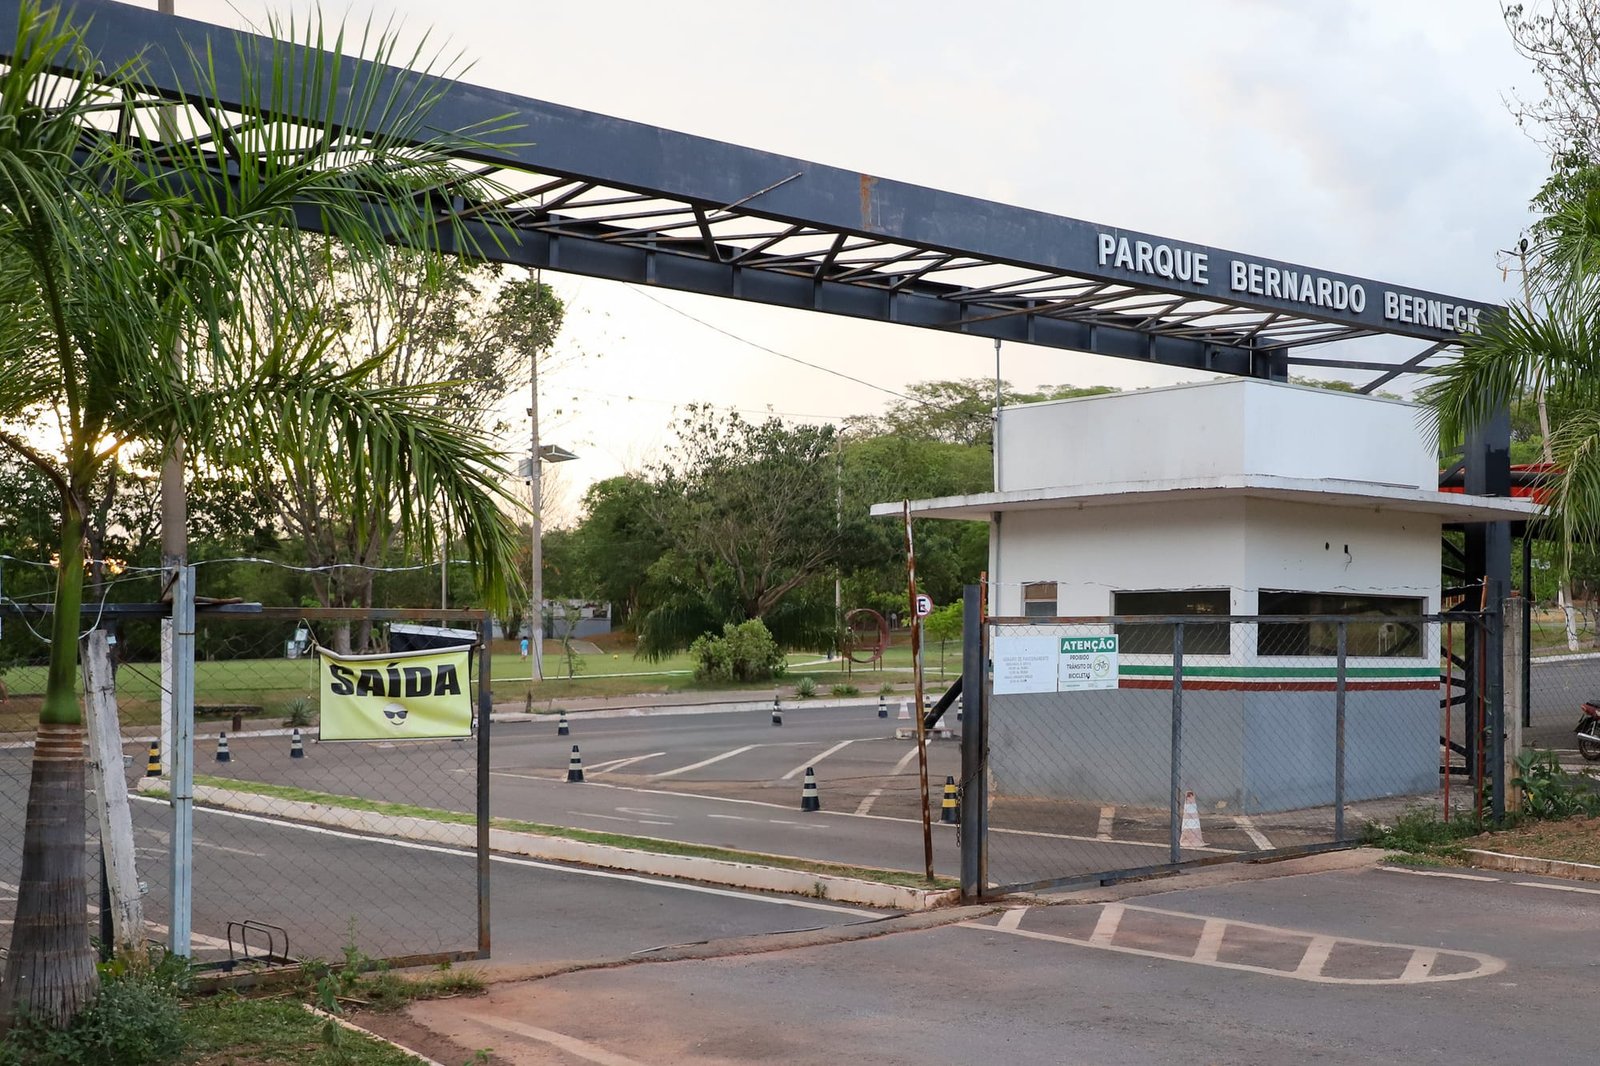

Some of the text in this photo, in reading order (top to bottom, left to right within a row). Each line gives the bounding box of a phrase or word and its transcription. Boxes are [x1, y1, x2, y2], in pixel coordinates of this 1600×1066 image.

[1097, 233, 1482, 335] PARQUE BERNARDO BERNECK
[918, 598, 926, 613] E
[1062, 638, 1115, 652] ATENÇÃO
[329, 662, 461, 698] SAÍDA
